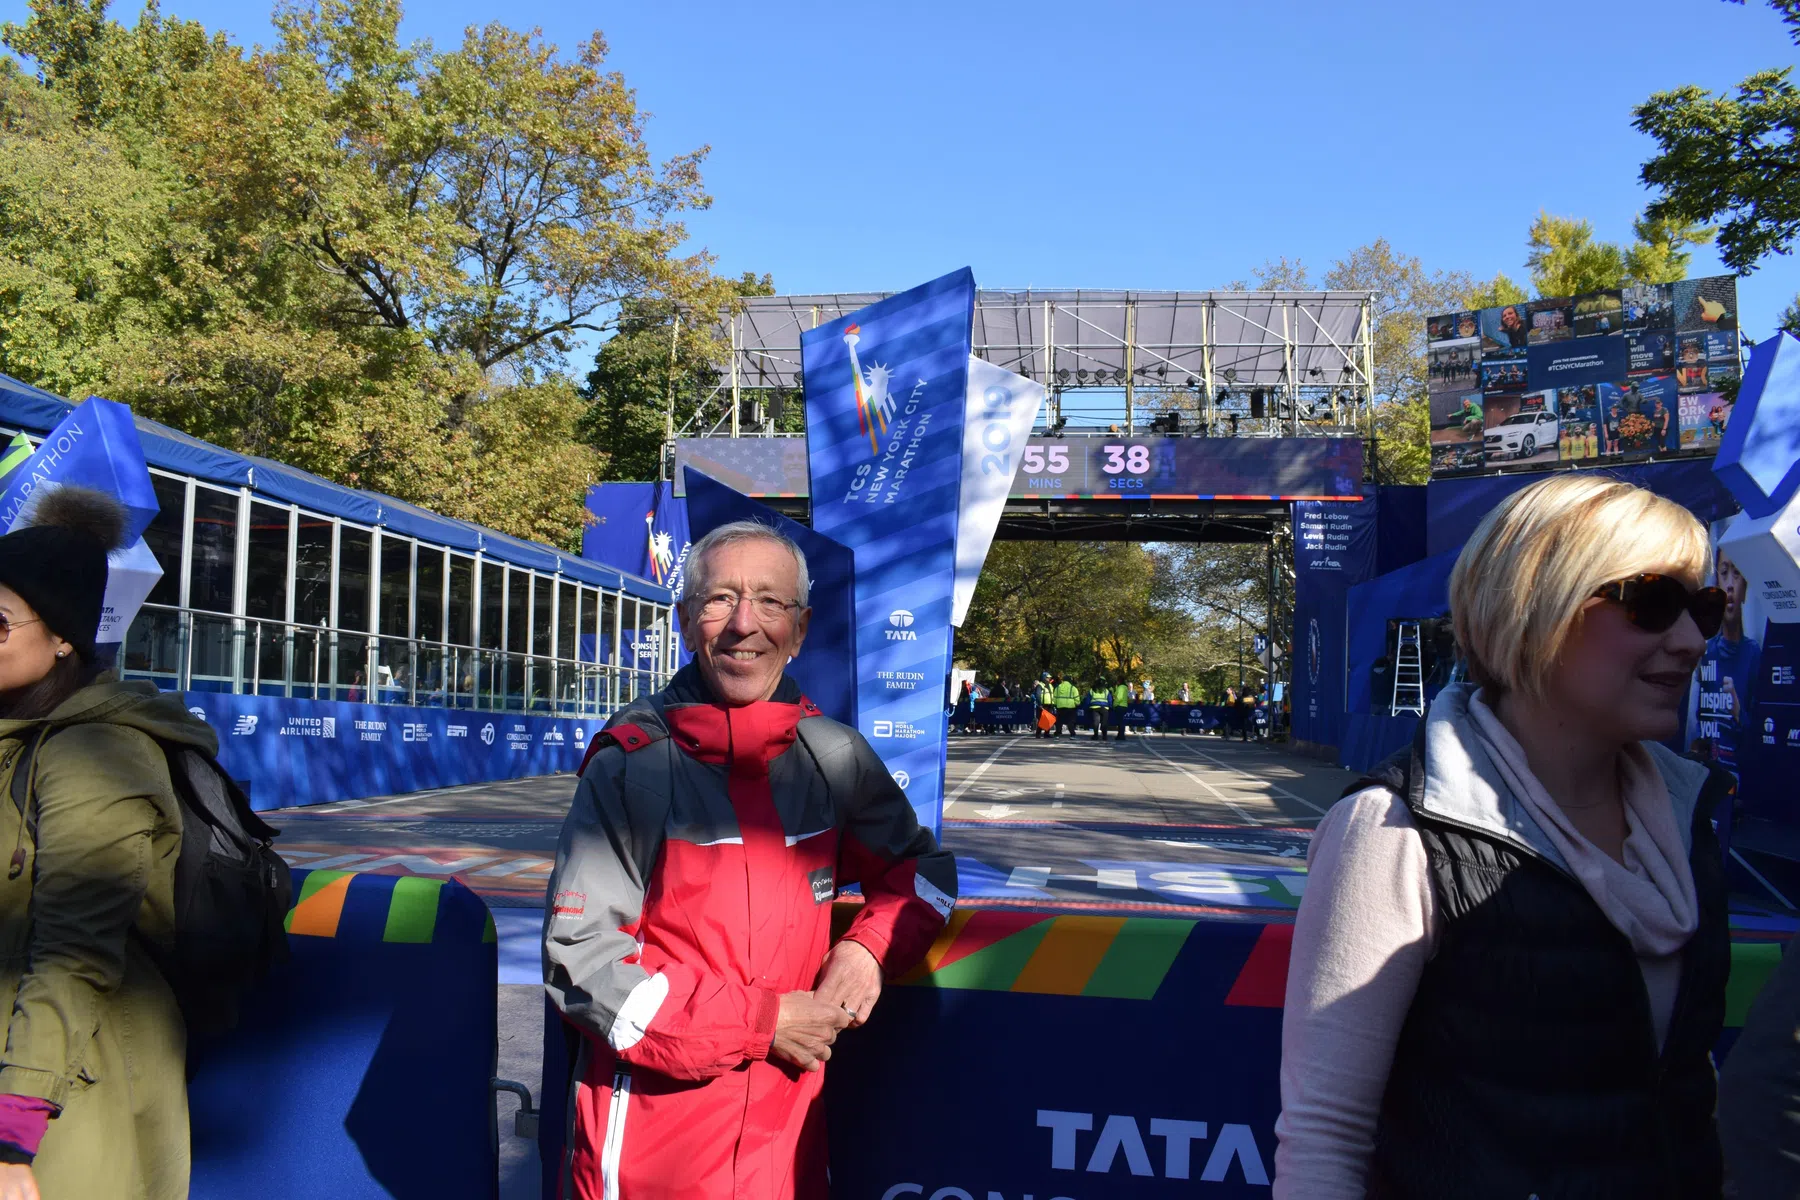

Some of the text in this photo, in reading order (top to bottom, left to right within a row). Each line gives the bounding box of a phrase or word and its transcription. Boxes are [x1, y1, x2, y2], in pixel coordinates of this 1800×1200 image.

[1548, 360, 1604, 372] #TCSNYCMarathon
[1631, 361, 1649, 369] you.
[1679, 396, 1698, 405] EW
[1679, 405, 1706, 416] ORK
[980, 384, 1012, 477] 2019
[865, 378, 928, 504] NEW YORK CITY
[884, 413, 932, 504] MARATHON
[1022, 445, 1150, 474] 55 38
[1, 422, 84, 528] MARATHON
[844, 463, 872, 504] TCS
[1029, 478, 1144, 489] MINS SECS
[678, 541, 692, 563] CITY
[1764, 580, 1782, 589] TATA
[1762, 590, 1798, 600] CONSULTANCY
[1773, 601, 1797, 610] SERVICES
[884, 630, 917, 640] TATA
[1258, 639, 1265, 649] H
[876, 671, 924, 680] THE RUDIN
[1700, 660, 1716, 681] will
[886, 681, 916, 690] FAMILY
[1700, 688, 1732, 712] inspire
[289, 717, 321, 726] UNITED
[354, 720, 387, 730] THE RUDIN
[280, 727, 321, 736] AIRLINES
[447, 725, 468, 737] ESPN
[1700, 721, 1720, 738] you.
[361, 732, 382, 742] FAMILY
[1762, 735, 1775, 744] TATA
[1037, 1110, 1270, 1186] TATA
